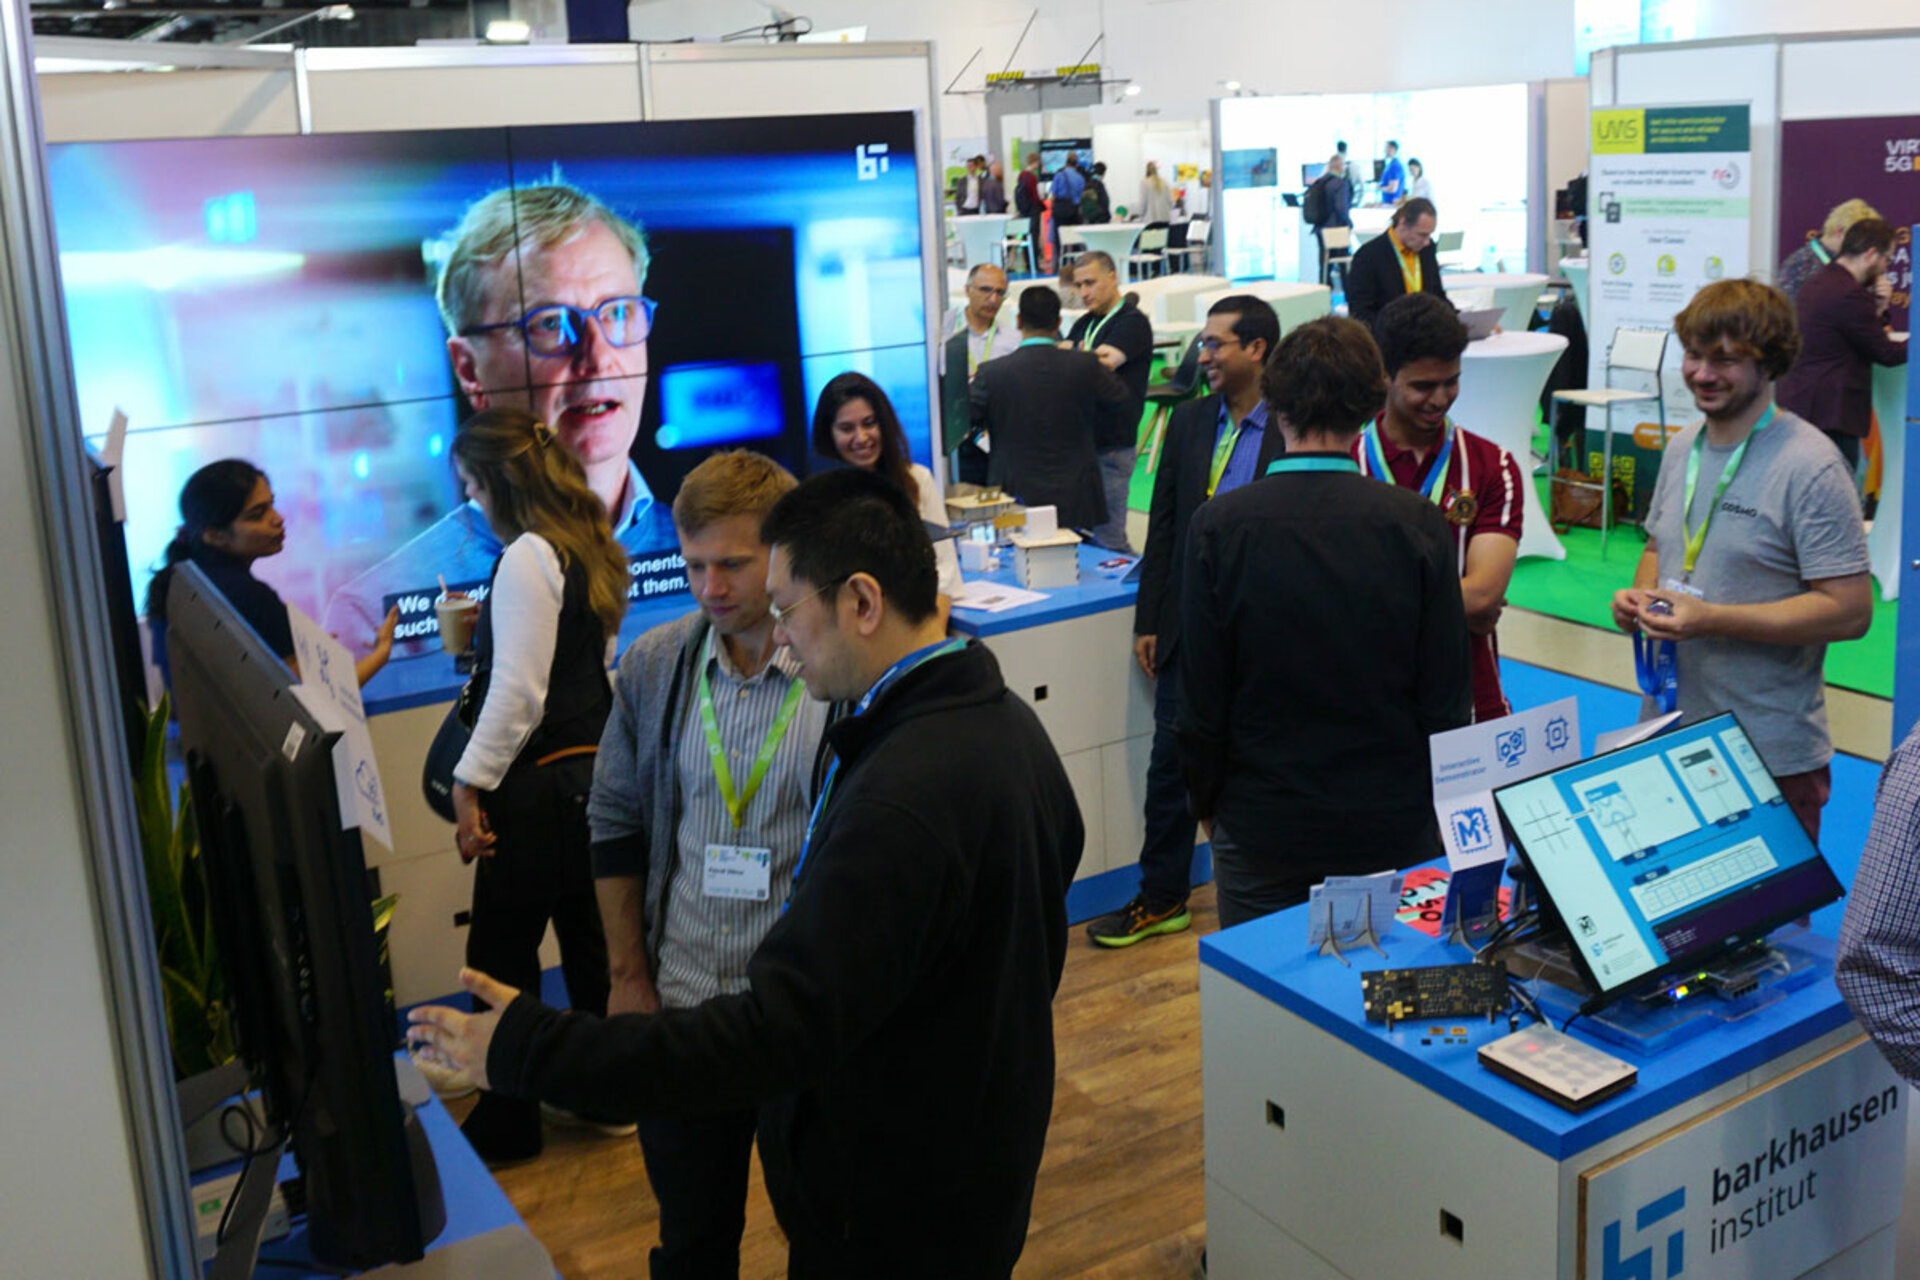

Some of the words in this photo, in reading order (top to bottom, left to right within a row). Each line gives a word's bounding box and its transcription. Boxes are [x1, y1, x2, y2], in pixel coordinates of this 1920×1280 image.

[393, 615, 439, 639] such
[397, 594, 430, 615] We
[1712, 1084, 1898, 1206] barkhausen
[1710, 1170, 1817, 1255] institut
